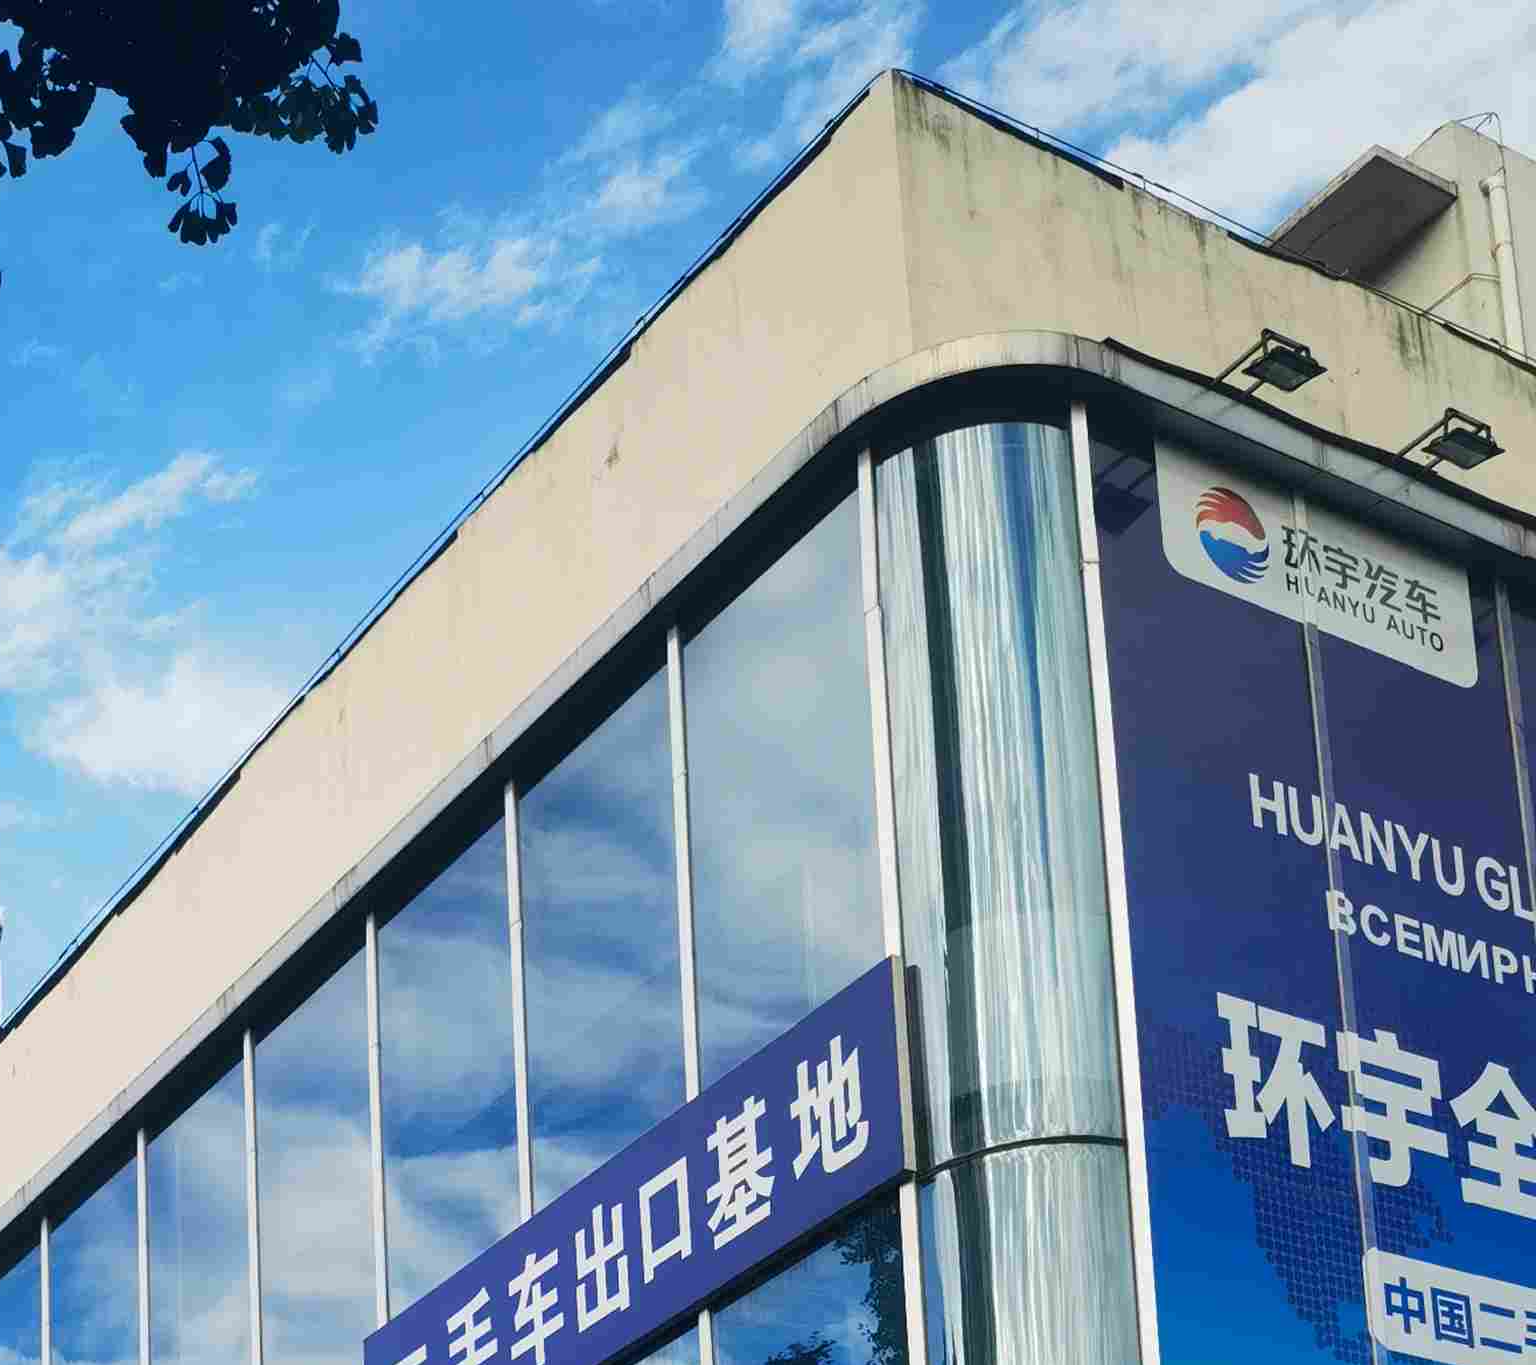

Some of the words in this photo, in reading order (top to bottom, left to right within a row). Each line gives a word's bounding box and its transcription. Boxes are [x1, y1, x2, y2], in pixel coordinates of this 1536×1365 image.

[1281, 525, 1441, 625] 环宇汽车
[1386, 614, 1444, 652] AUTO
[1248, 772, 1465, 896] HUANYU
[1216, 991, 1536, 1220] 环宇全
[1383, 1276, 1536, 1355] 中国二
